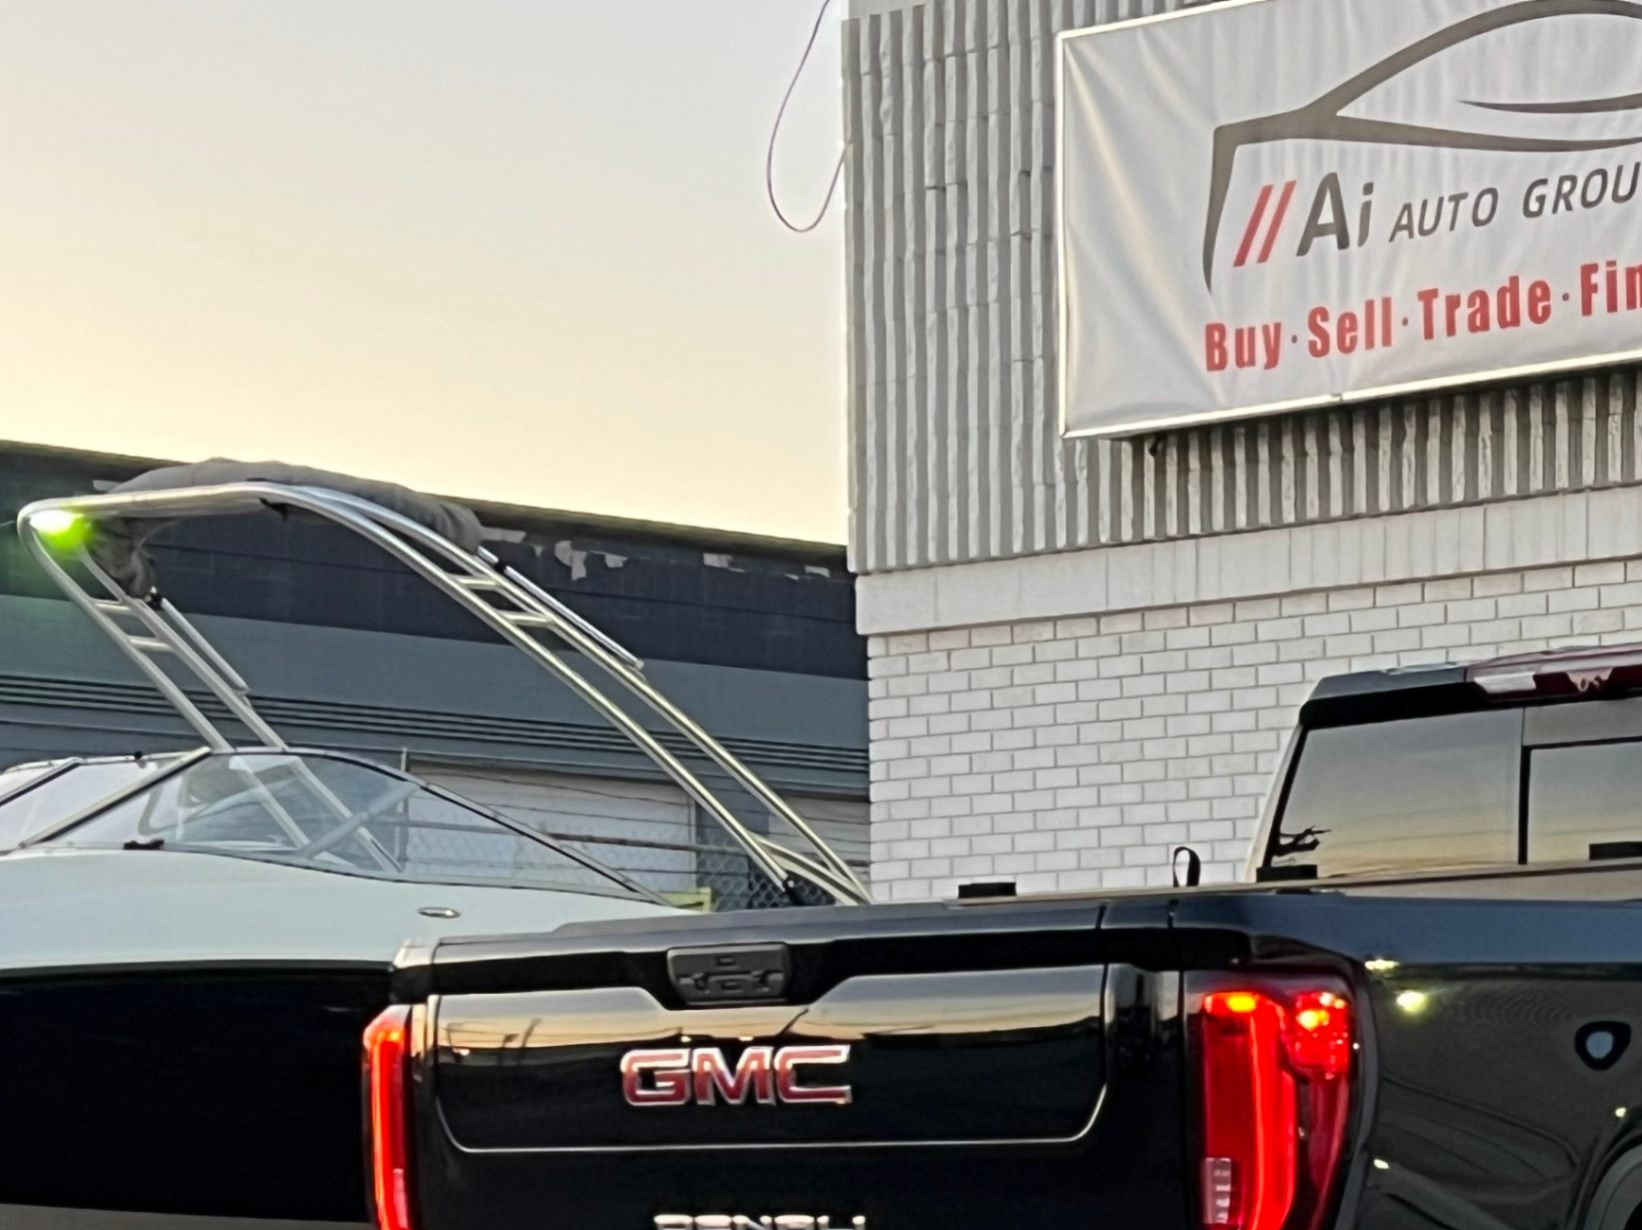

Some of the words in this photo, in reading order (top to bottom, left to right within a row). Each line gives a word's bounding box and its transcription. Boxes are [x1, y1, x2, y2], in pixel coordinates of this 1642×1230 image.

[1296, 172, 1374, 257] Ai
[1389, 188, 1499, 242] AUTO
[620, 1044, 853, 1107] GMC
